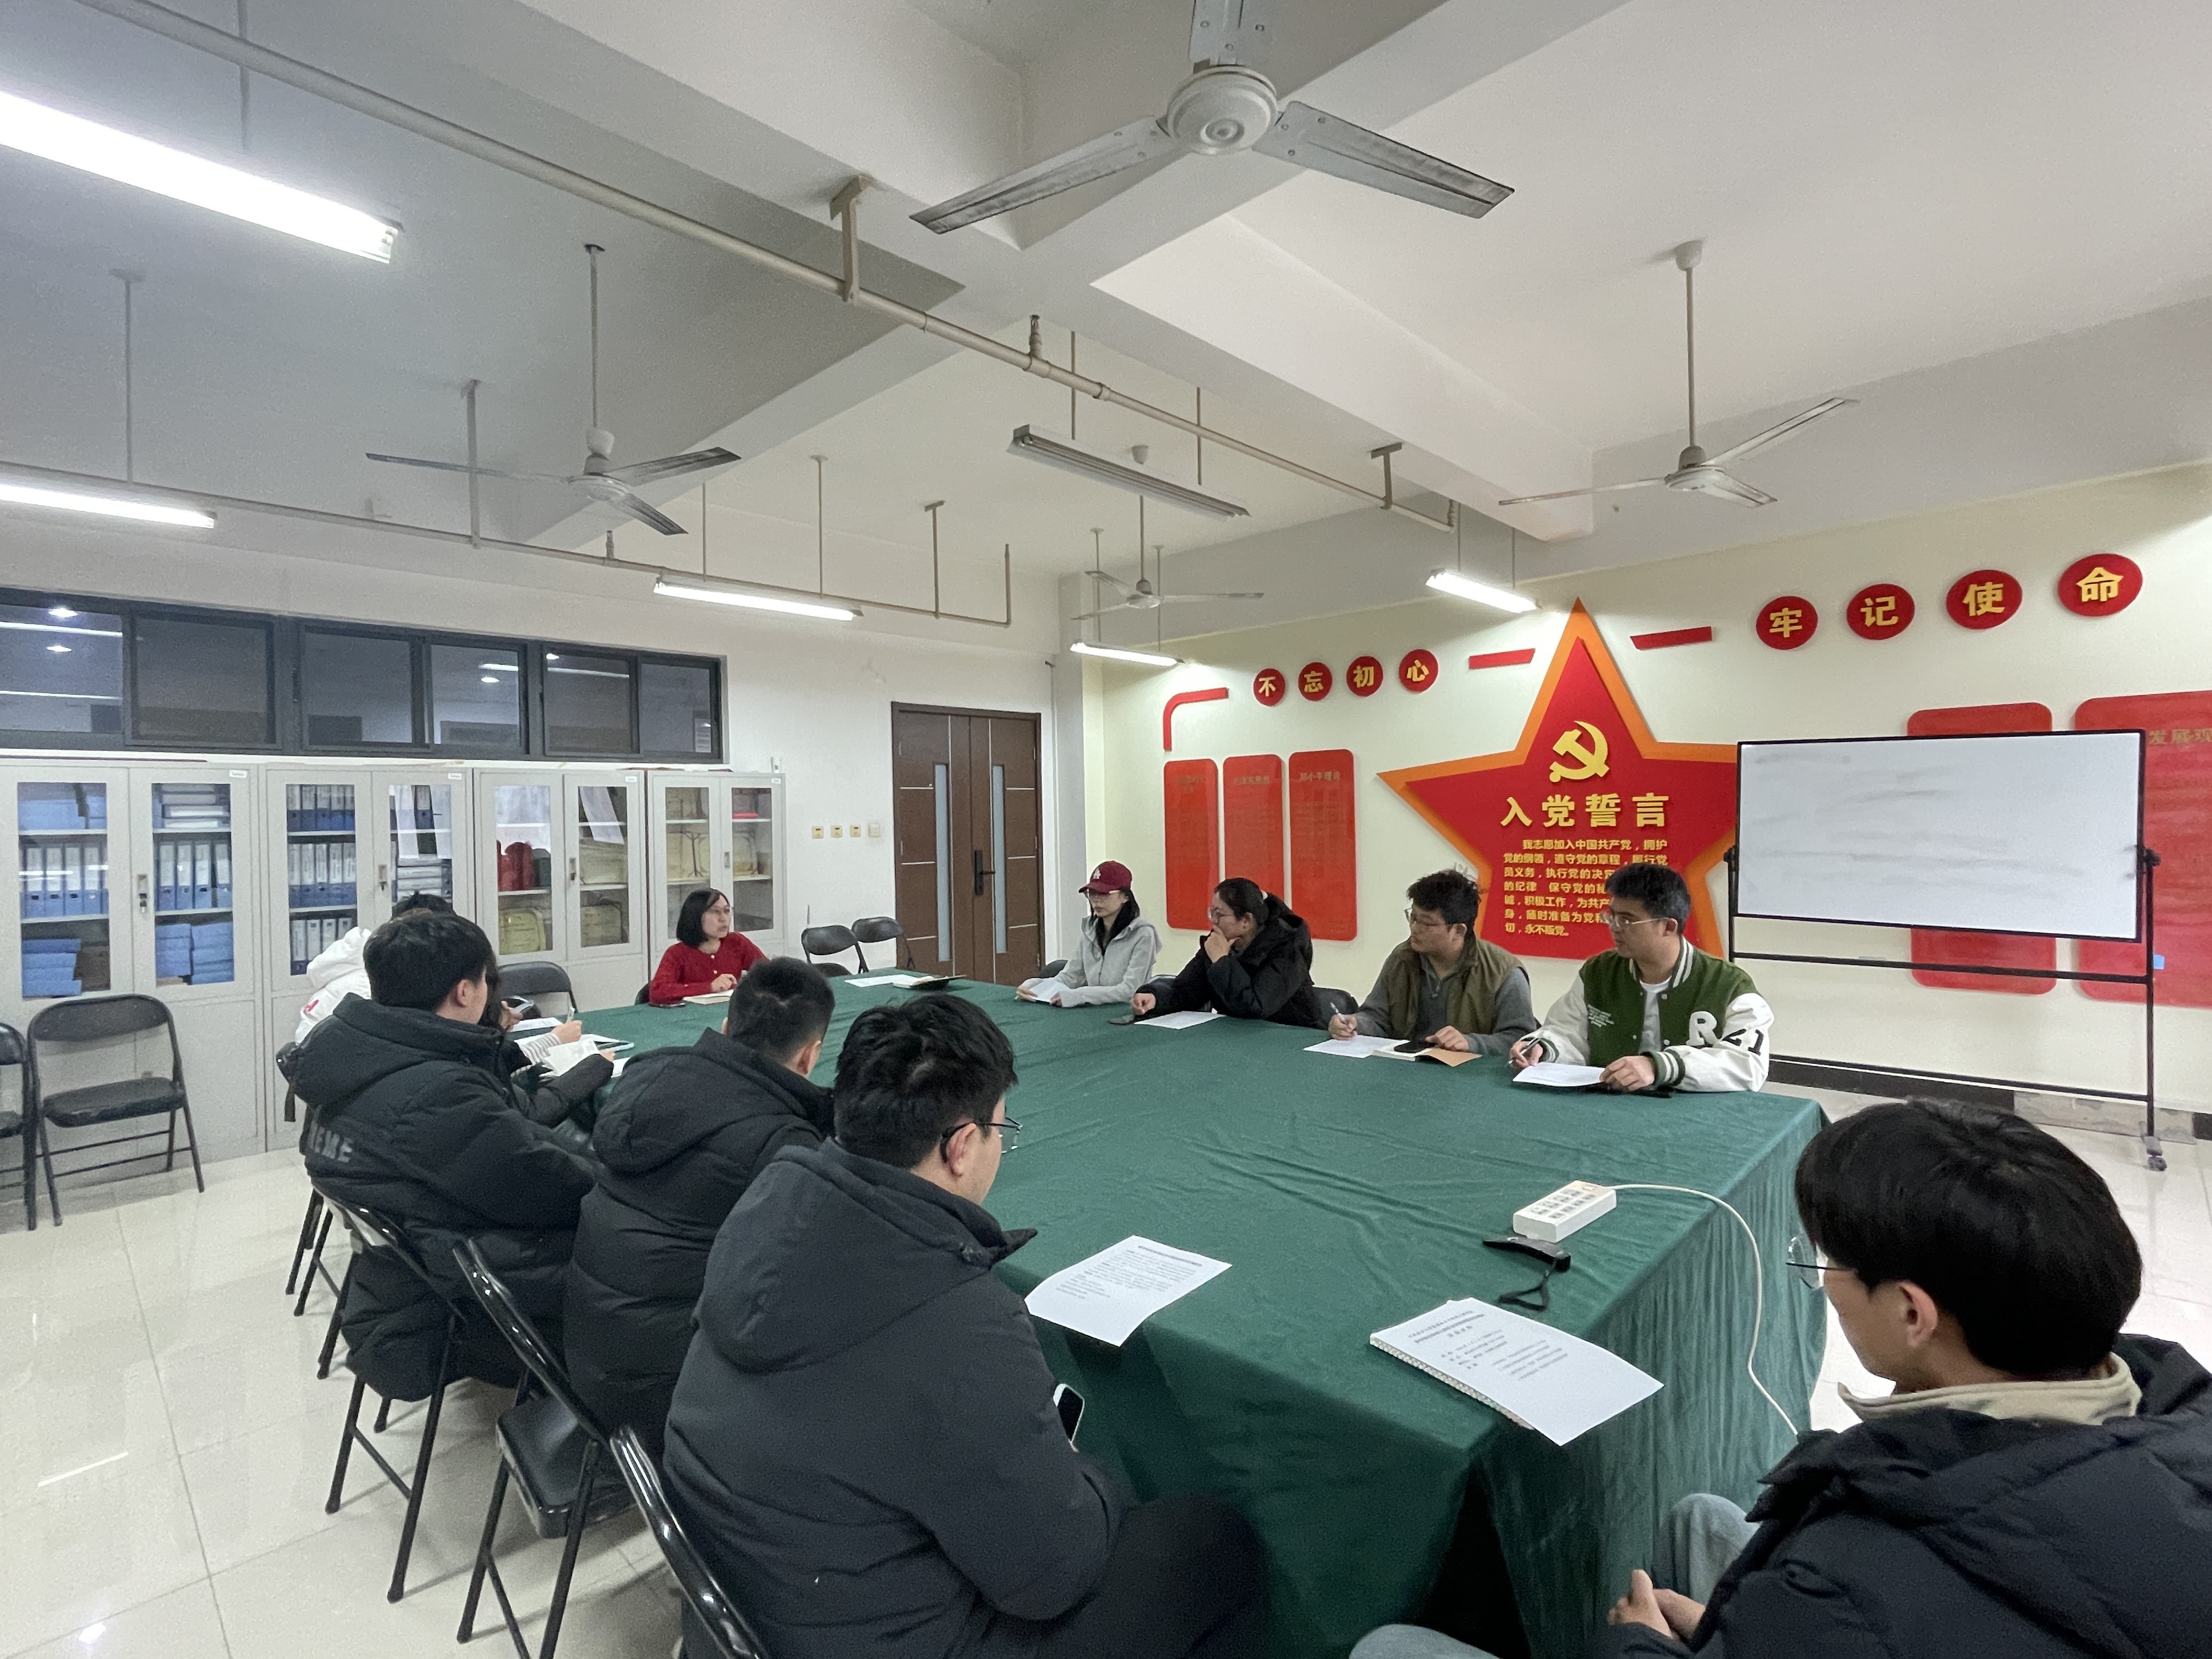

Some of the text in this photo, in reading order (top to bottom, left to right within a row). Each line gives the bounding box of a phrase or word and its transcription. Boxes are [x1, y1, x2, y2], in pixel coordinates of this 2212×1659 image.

[1769, 566, 2124, 638] 牢记使命
[1258, 659, 1430, 697] 不忘初心
[1500, 792, 1669, 827] 入党誓言
[1686, 1011, 1720, 1046] R
